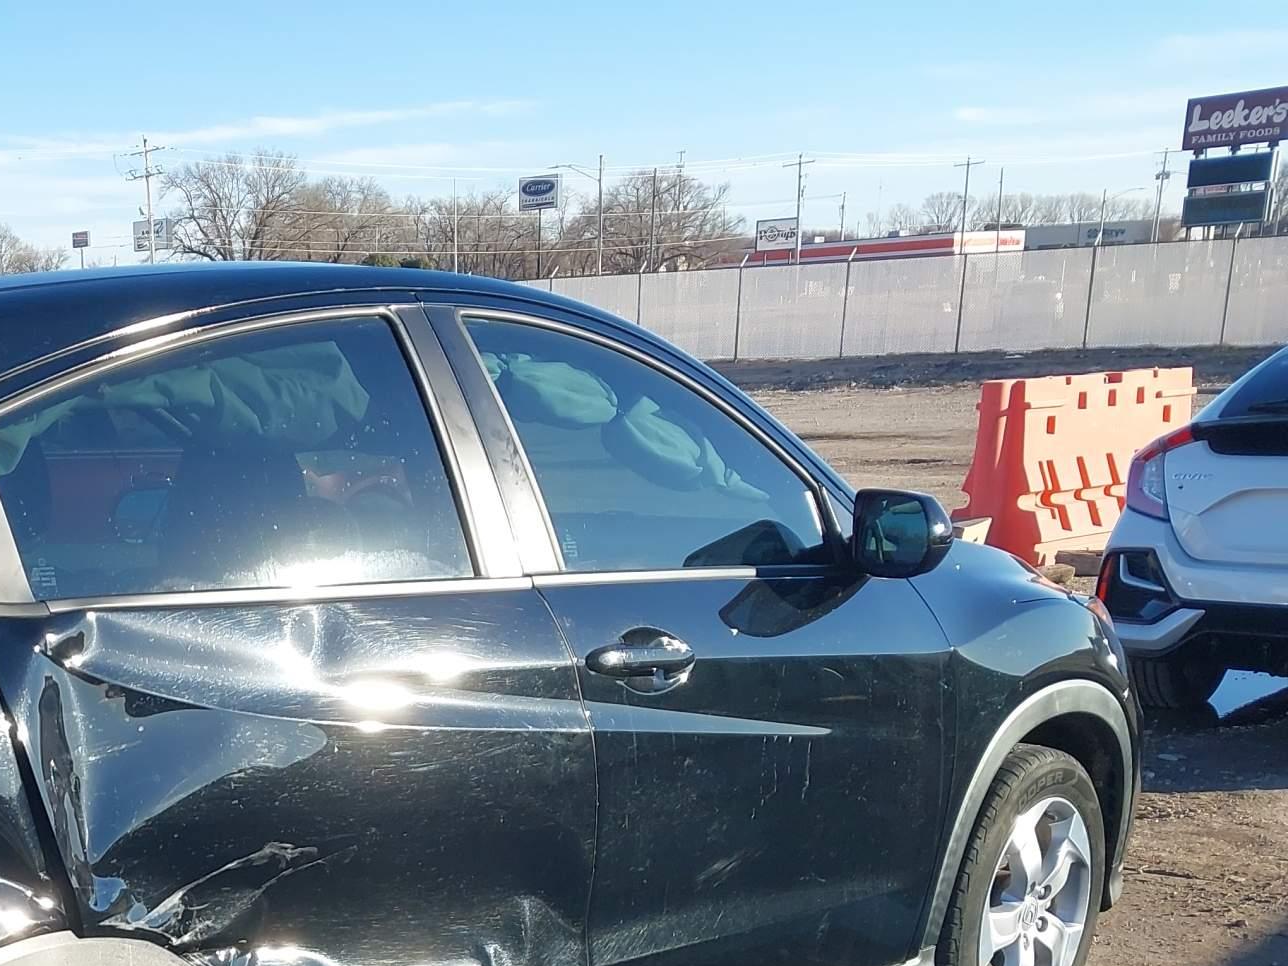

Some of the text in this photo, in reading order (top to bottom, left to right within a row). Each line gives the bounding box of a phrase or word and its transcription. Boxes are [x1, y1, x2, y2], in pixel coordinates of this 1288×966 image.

[1188, 99, 1288, 132] Leeker's
[1191, 127, 1280, 144] FAMILY FOODS
[526, 182, 551, 192] Carrier
